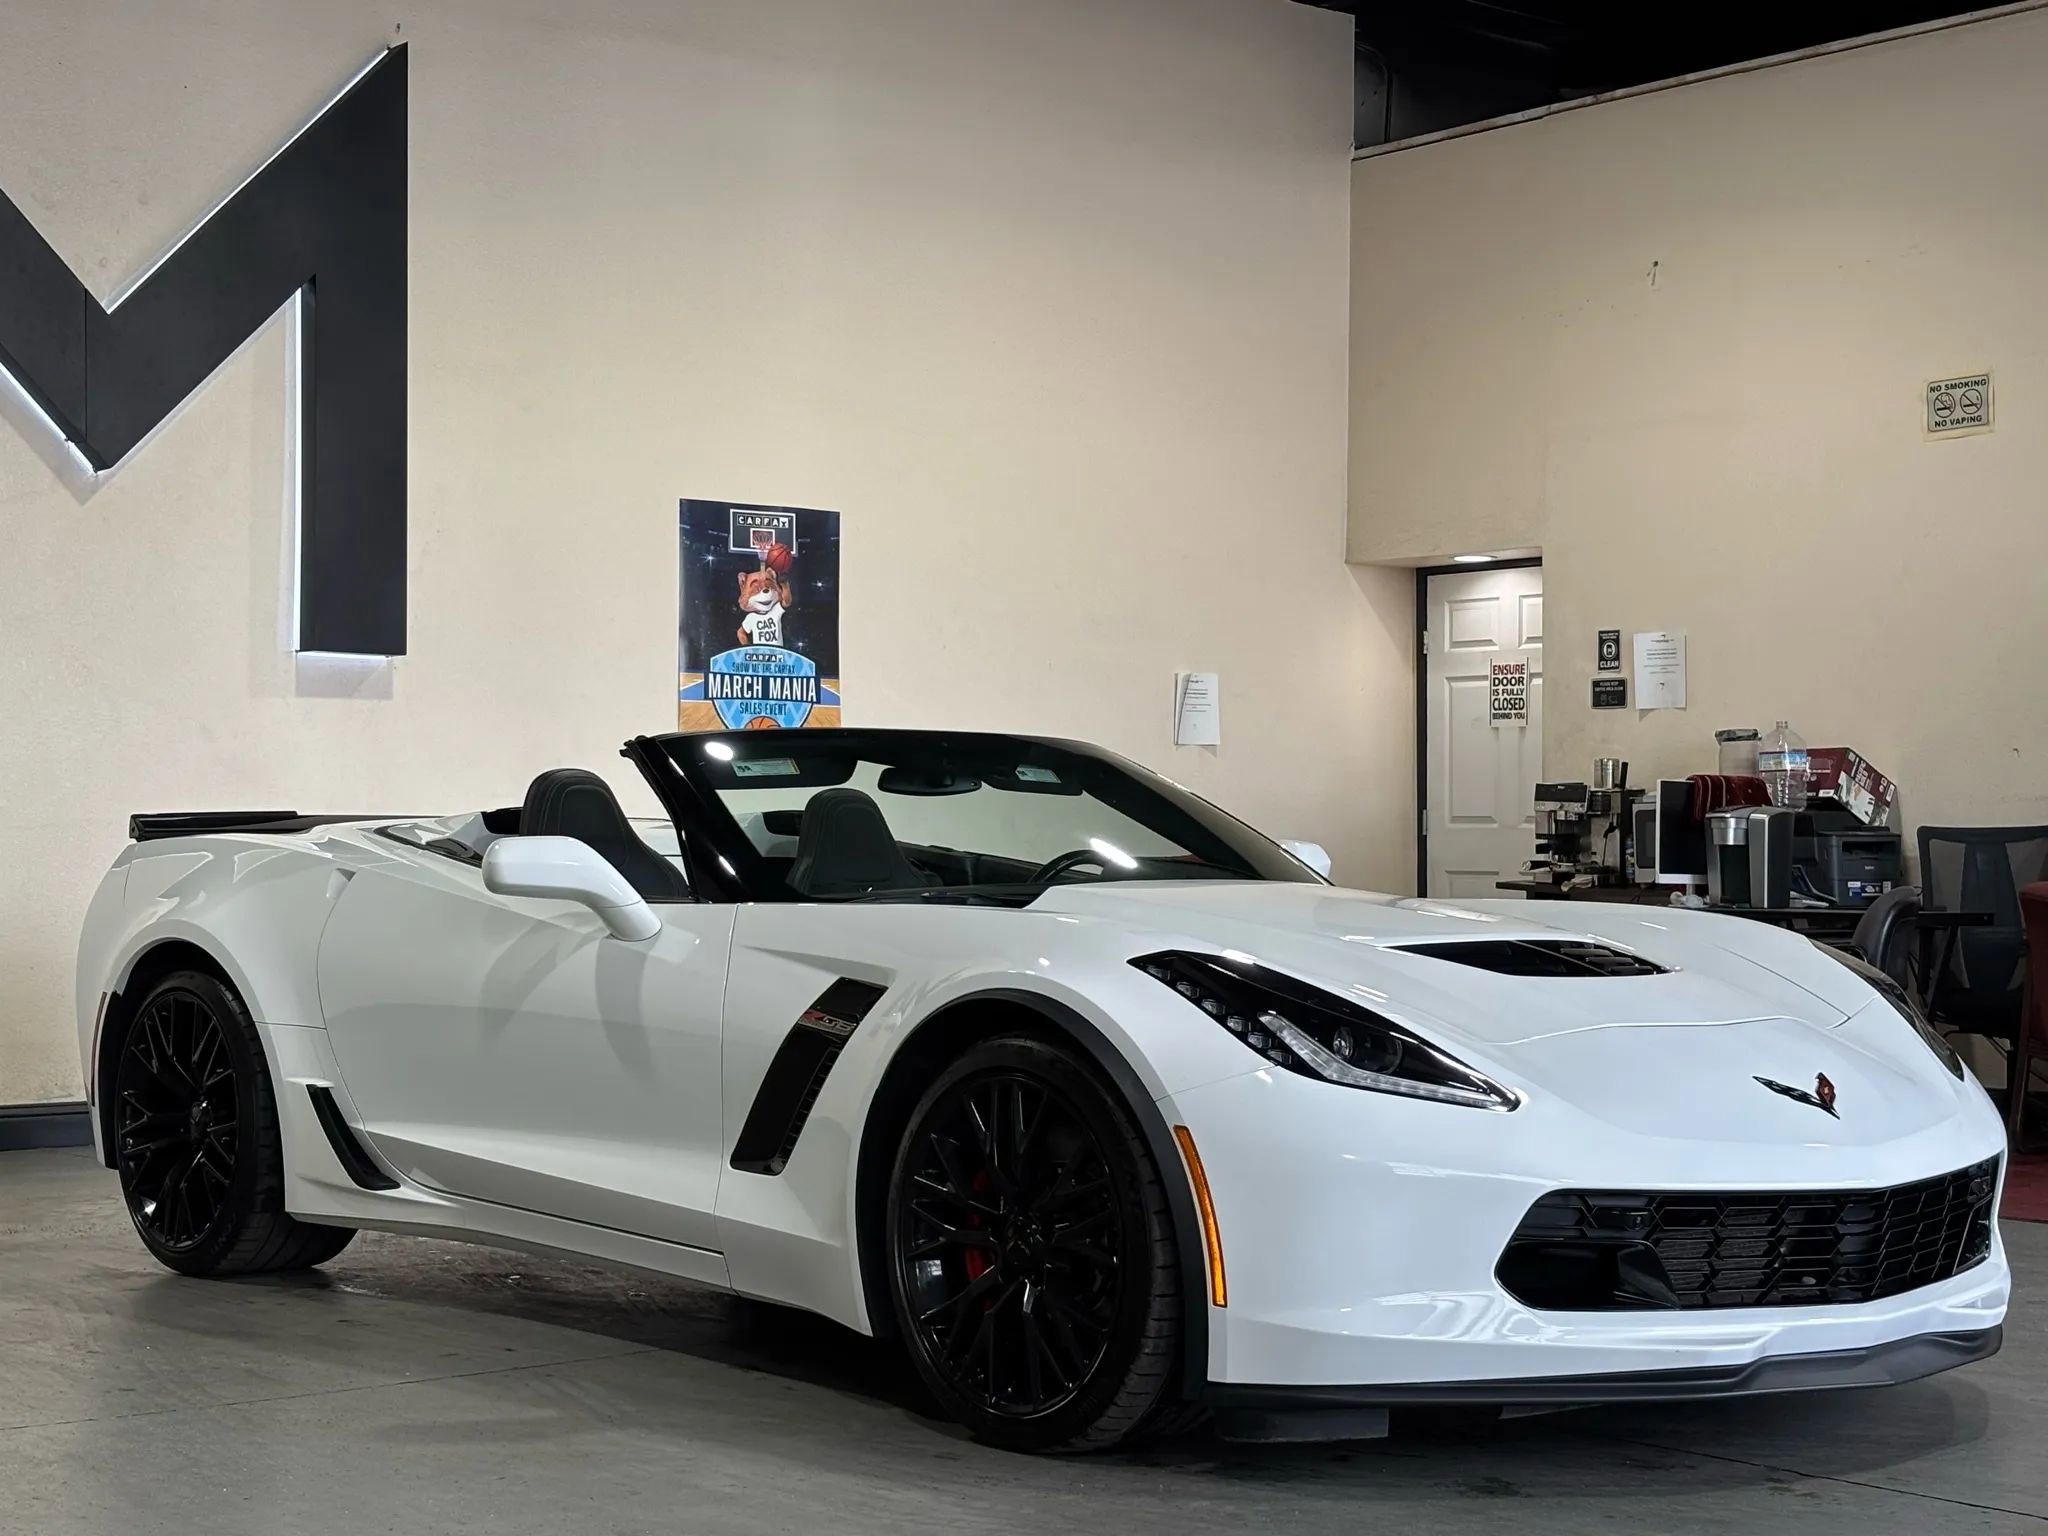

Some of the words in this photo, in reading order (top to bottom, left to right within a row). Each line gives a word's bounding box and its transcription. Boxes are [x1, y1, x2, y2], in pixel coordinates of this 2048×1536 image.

[1930, 385, 1941, 393] NO
[1944, 379, 1986, 390] SMOKING
[1934, 419, 1947, 428] NO
[1949, 415, 1982, 425] VAPING
[738, 515, 789, 528] CARFAX
[756, 617, 776, 631] CAR
[758, 629, 778, 642] FOX
[732, 662, 750, 673] SHOW
[752, 663, 761, 673] ME
[762, 664, 772, 674] THE
[774, 664, 796, 675] CARFAX
[1492, 663, 1526, 675] ENSURE
[708, 673, 762, 699] MARCH
[769, 677, 817, 702] MANIA
[1492, 676, 1525, 687] DOOR
[1492, 688, 1500, 696] IS
[1501, 688, 1525, 696] FULLY
[740, 702, 762, 714] SALES
[765, 703, 787, 715] EVENT
[1492, 697, 1525, 711] CLOSED
[1492, 712, 1513, 720] BEHIND
[1513, 712, 1525, 720] YOU
